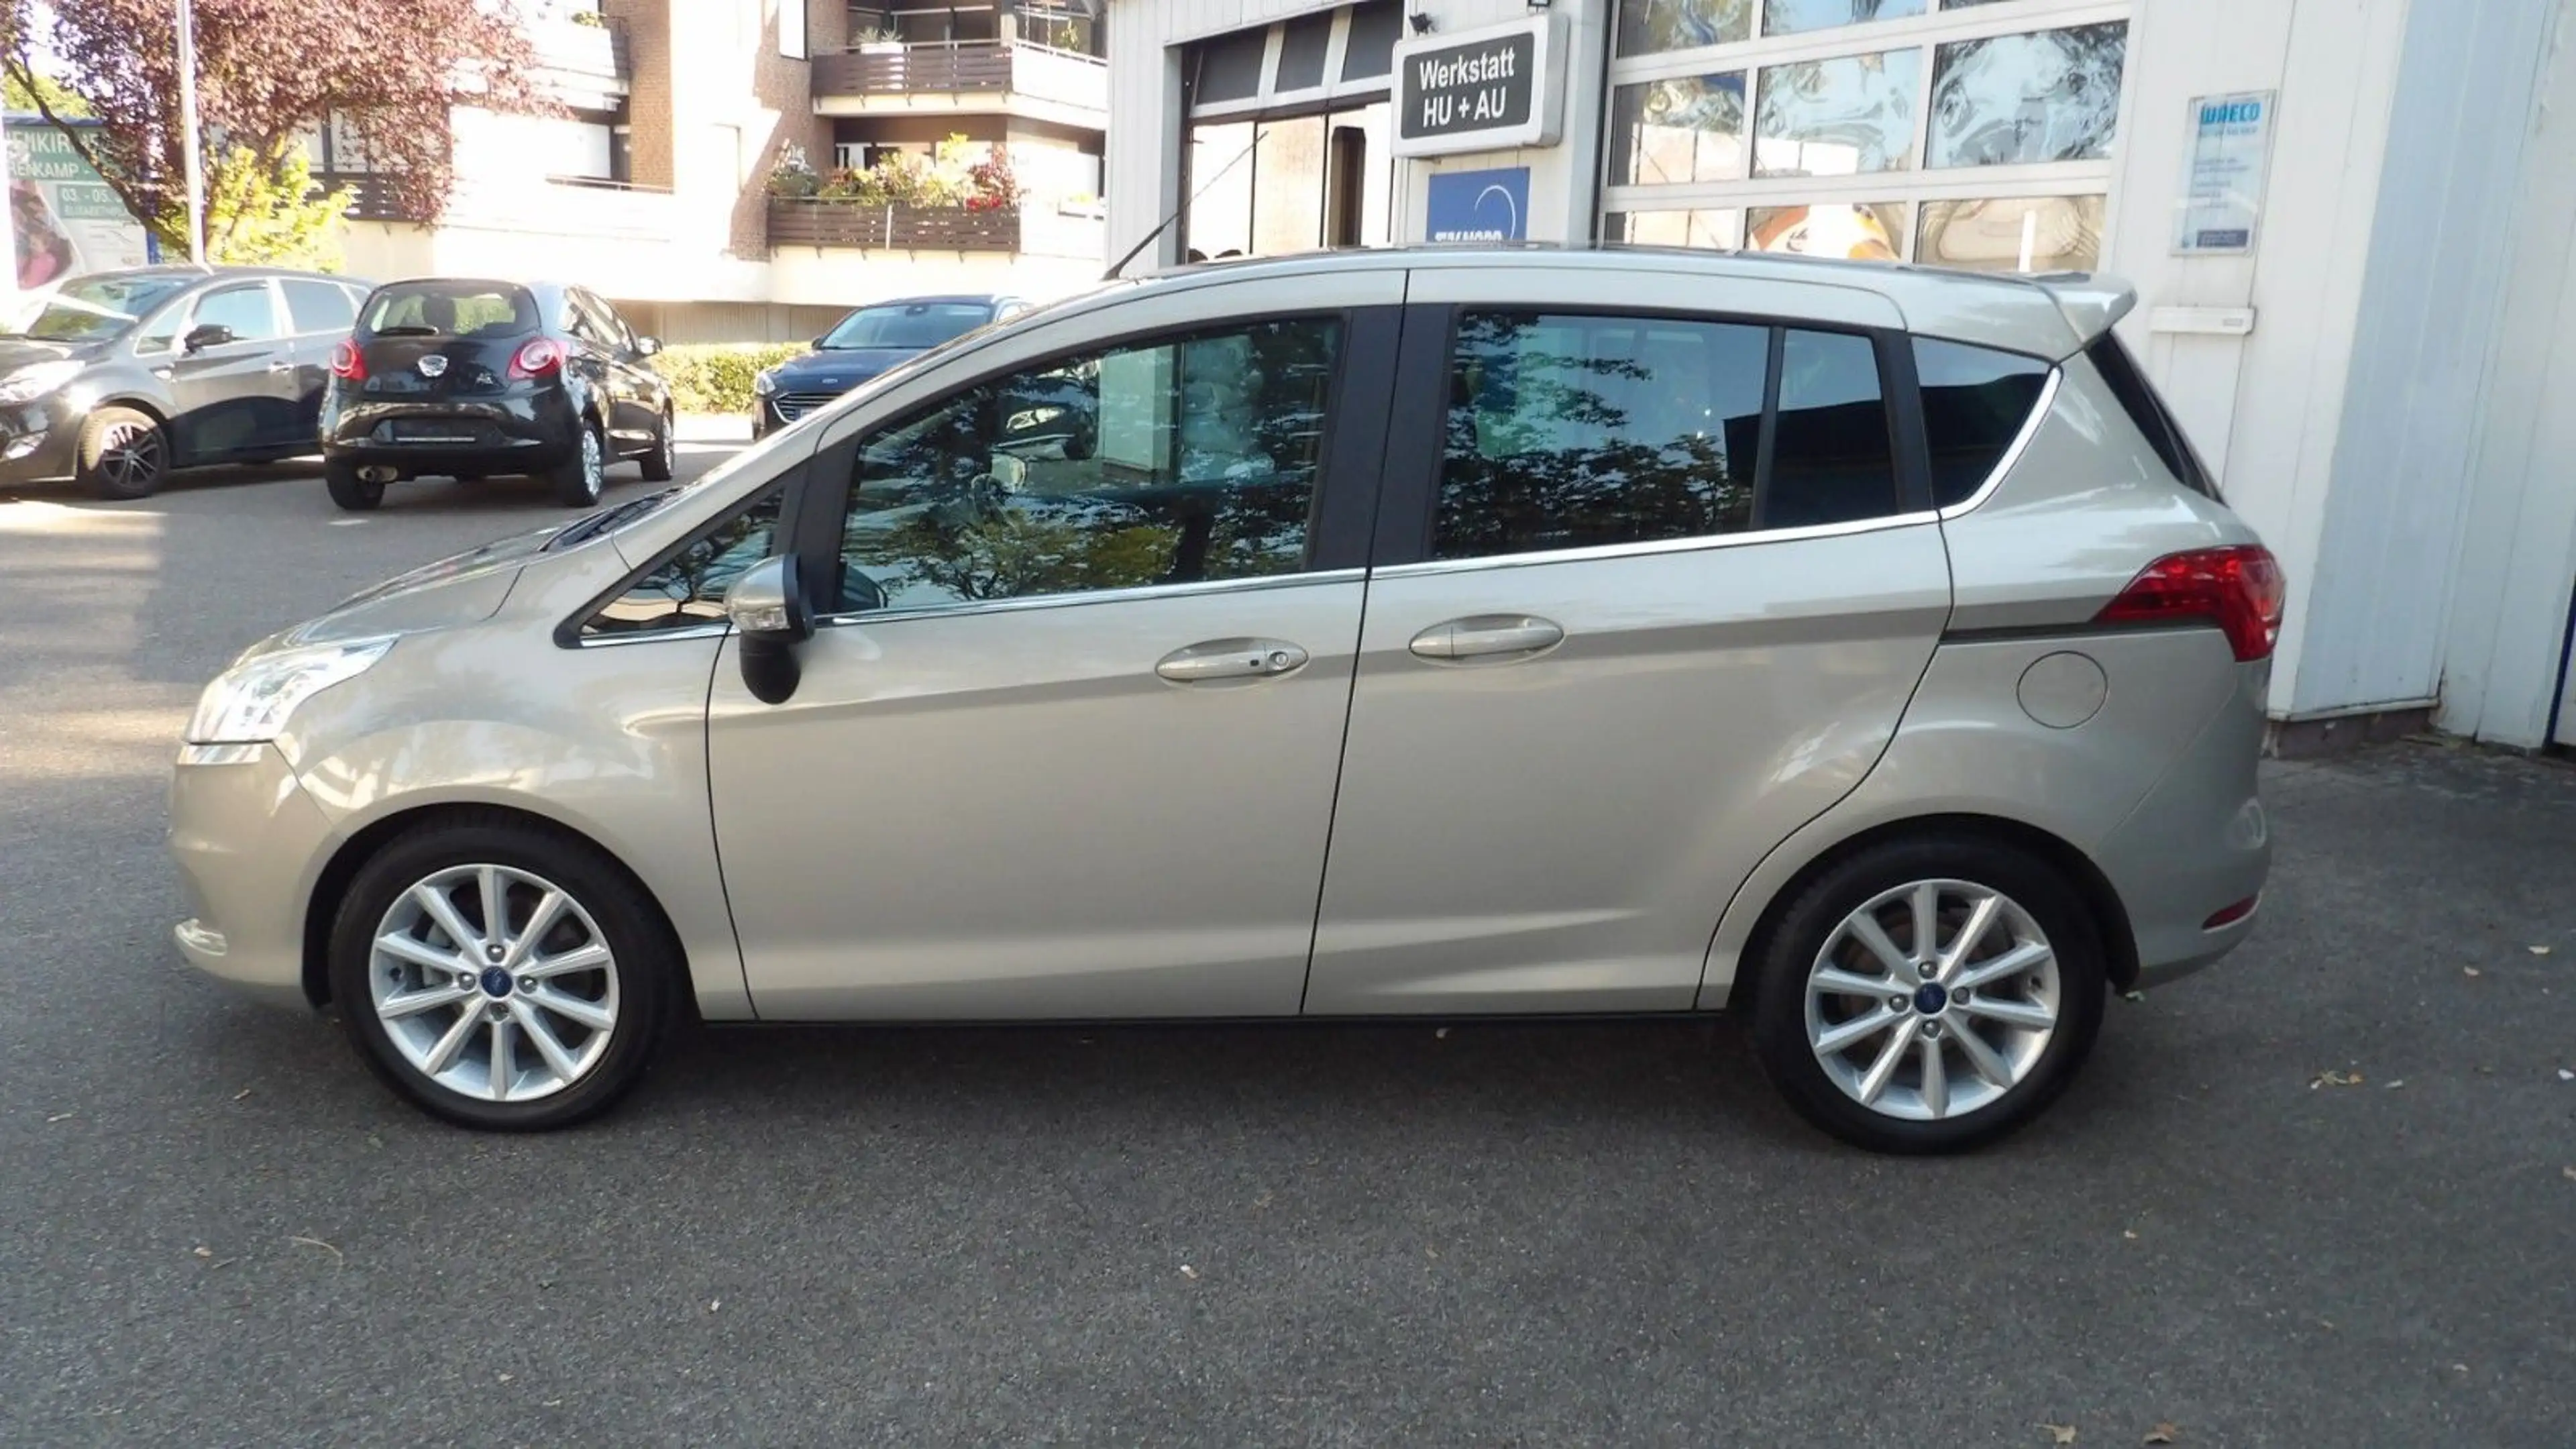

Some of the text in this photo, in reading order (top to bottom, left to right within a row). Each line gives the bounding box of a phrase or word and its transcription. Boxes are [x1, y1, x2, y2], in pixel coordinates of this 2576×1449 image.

[1419, 45, 1515, 91] Werkstatt
[1423, 87, 1507, 128] HU + AU
